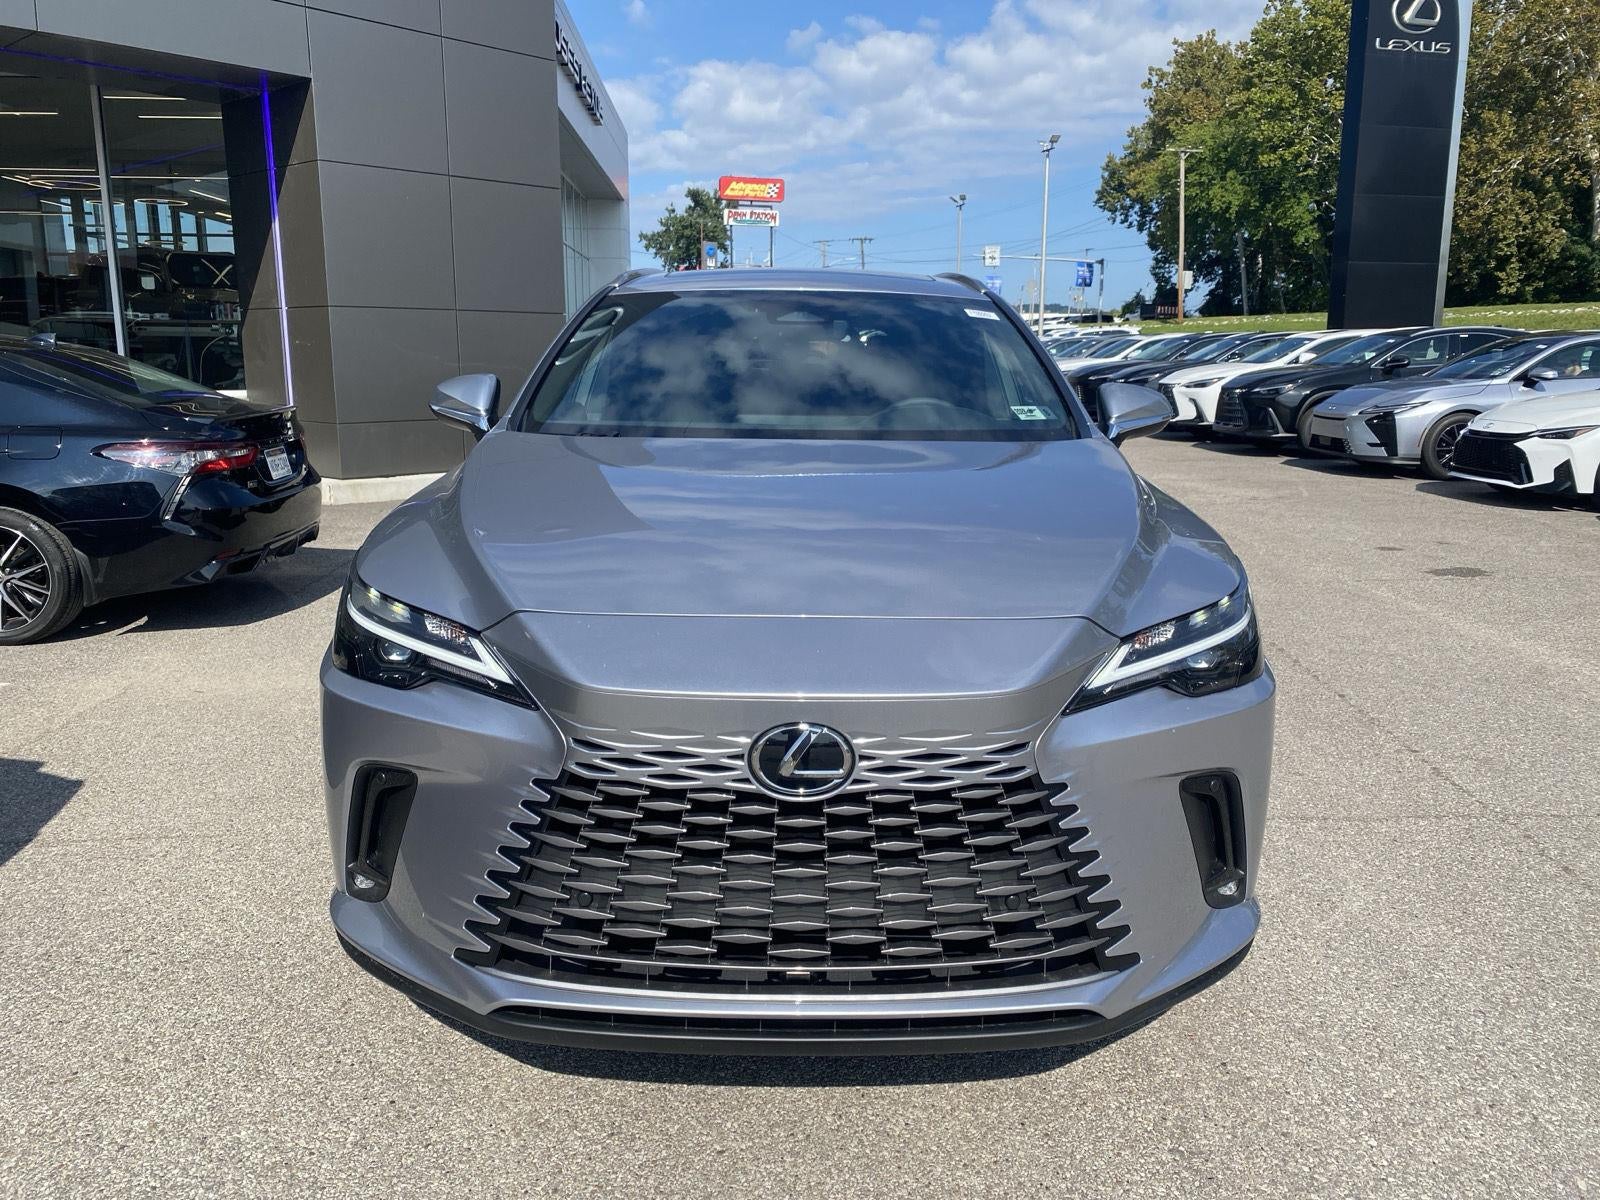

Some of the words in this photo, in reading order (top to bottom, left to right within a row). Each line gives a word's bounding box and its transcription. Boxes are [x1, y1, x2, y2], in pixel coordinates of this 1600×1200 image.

[1375, 37, 1452, 54] LEXUS
[730, 181, 766, 191] Advance
[724, 188, 744, 196] Auto
[744, 189, 764, 198] Parts
[749, 210, 777, 225] STATION
